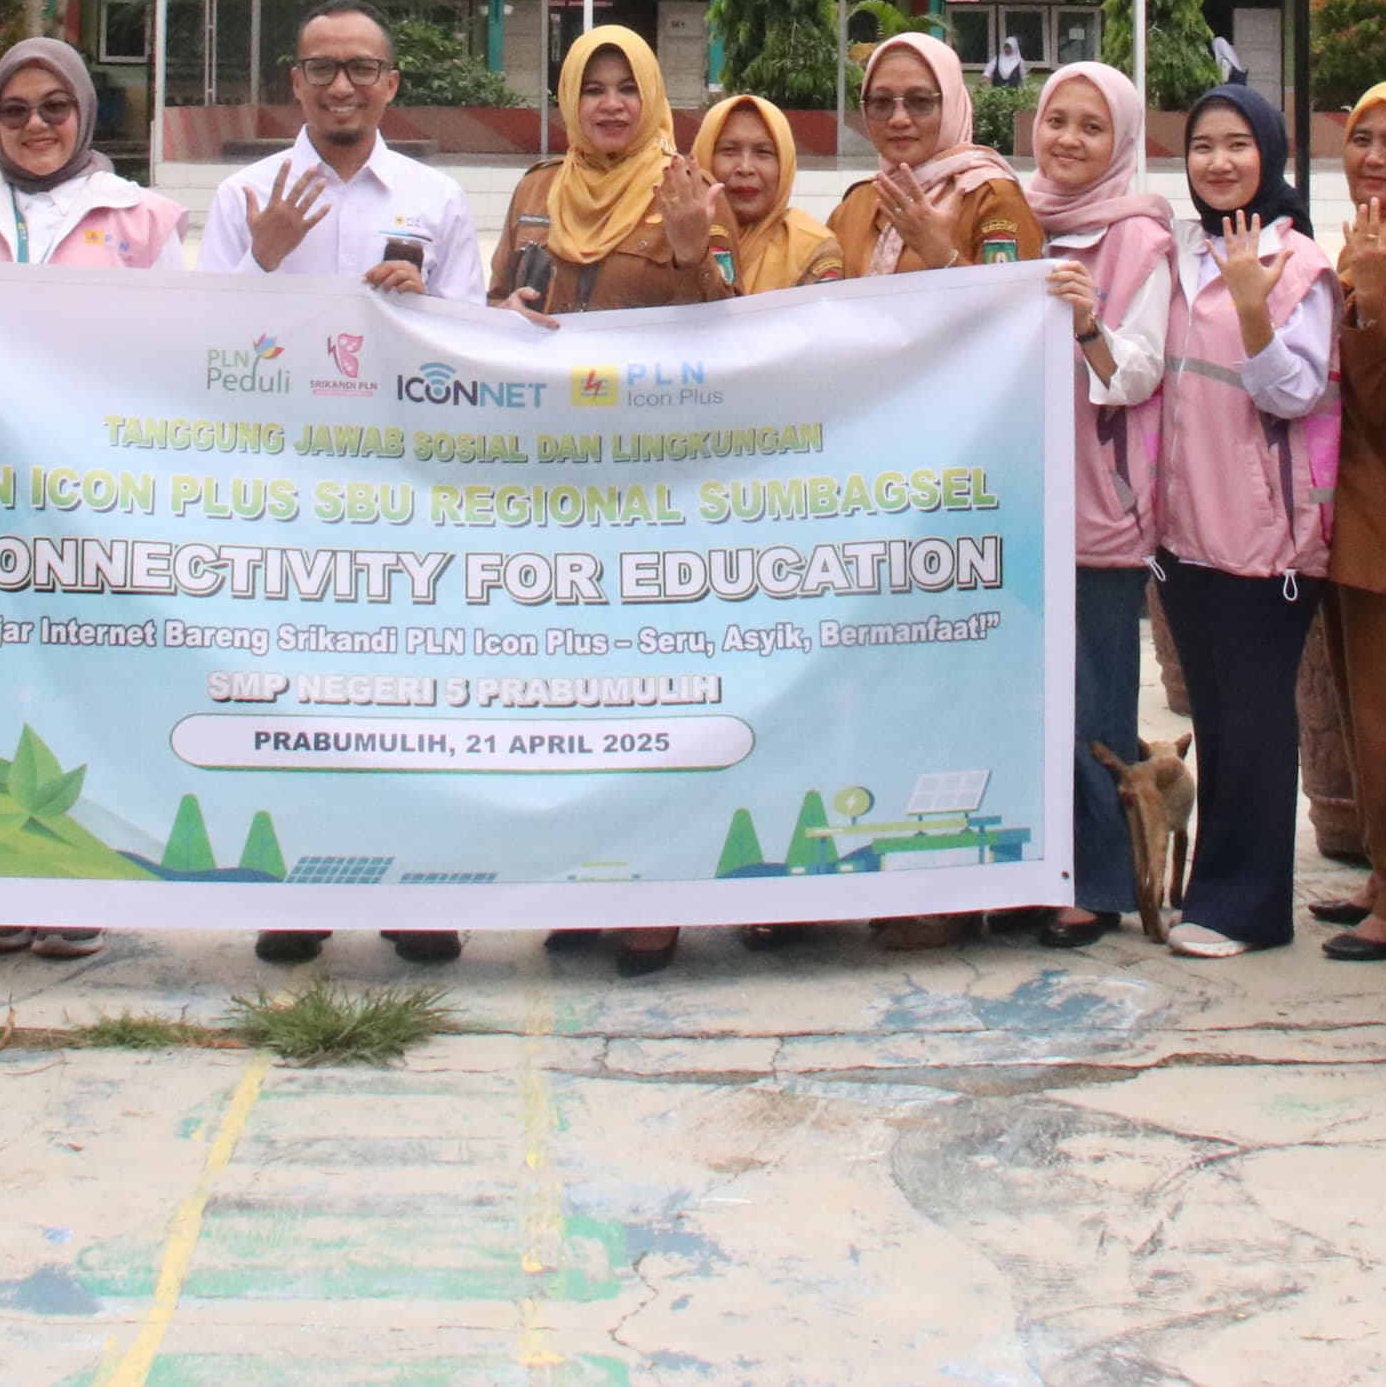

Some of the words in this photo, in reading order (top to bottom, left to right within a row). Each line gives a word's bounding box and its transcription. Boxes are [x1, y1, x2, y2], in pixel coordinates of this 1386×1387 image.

[207, 349, 249, 368] PLN
[627, 361, 704, 386] PLN
[206, 364, 291, 393] Peduli
[309, 380, 356, 390] SRIKANDI
[359, 382, 377, 390] PLN
[397, 374, 547, 409] ICONNET
[627, 390, 672, 407] Icon
[680, 388, 724, 406] Plus
[104, 415, 284, 453] TANGGUNG
[294, 426, 405, 461] JAWAB
[414, 431, 528, 463] SOSIAL
[536, 433, 602, 463] DAN
[612, 422, 823, 462] LINGKUNGAN
[30, 466, 155, 516] ICON
[171, 475, 298, 519] PLUS
[313, 481, 413, 524] SBU
[431, 484, 685, 527] REGIONAL
[698, 468, 998, 524] SUMBAGSEL
[465, 551, 608, 605] FOR
[619, 535, 1003, 600] EDUCATION
[40, 616, 156, 648] Internet
[164, 620, 268, 655] Bareng
[277, 626, 397, 654] Srikandi
[406, 628, 466, 655] PLN
[474, 629, 538, 655] Icon
[546, 628, 608, 655] Plus
[639, 627, 715, 658] Seru,
[723, 623, 811, 657] Asyik,
[208, 671, 287, 704] SMP
[297, 674, 436, 706] NEGERI
[444, 676, 470, 706] 5
[477, 674, 722, 707] PRABUMULIH
[253, 730, 455, 758] PRABUMULIH,
[466, 733, 497, 754] 21
[509, 732, 594, 754] APRIL
[602, 731, 670, 754] 2025
